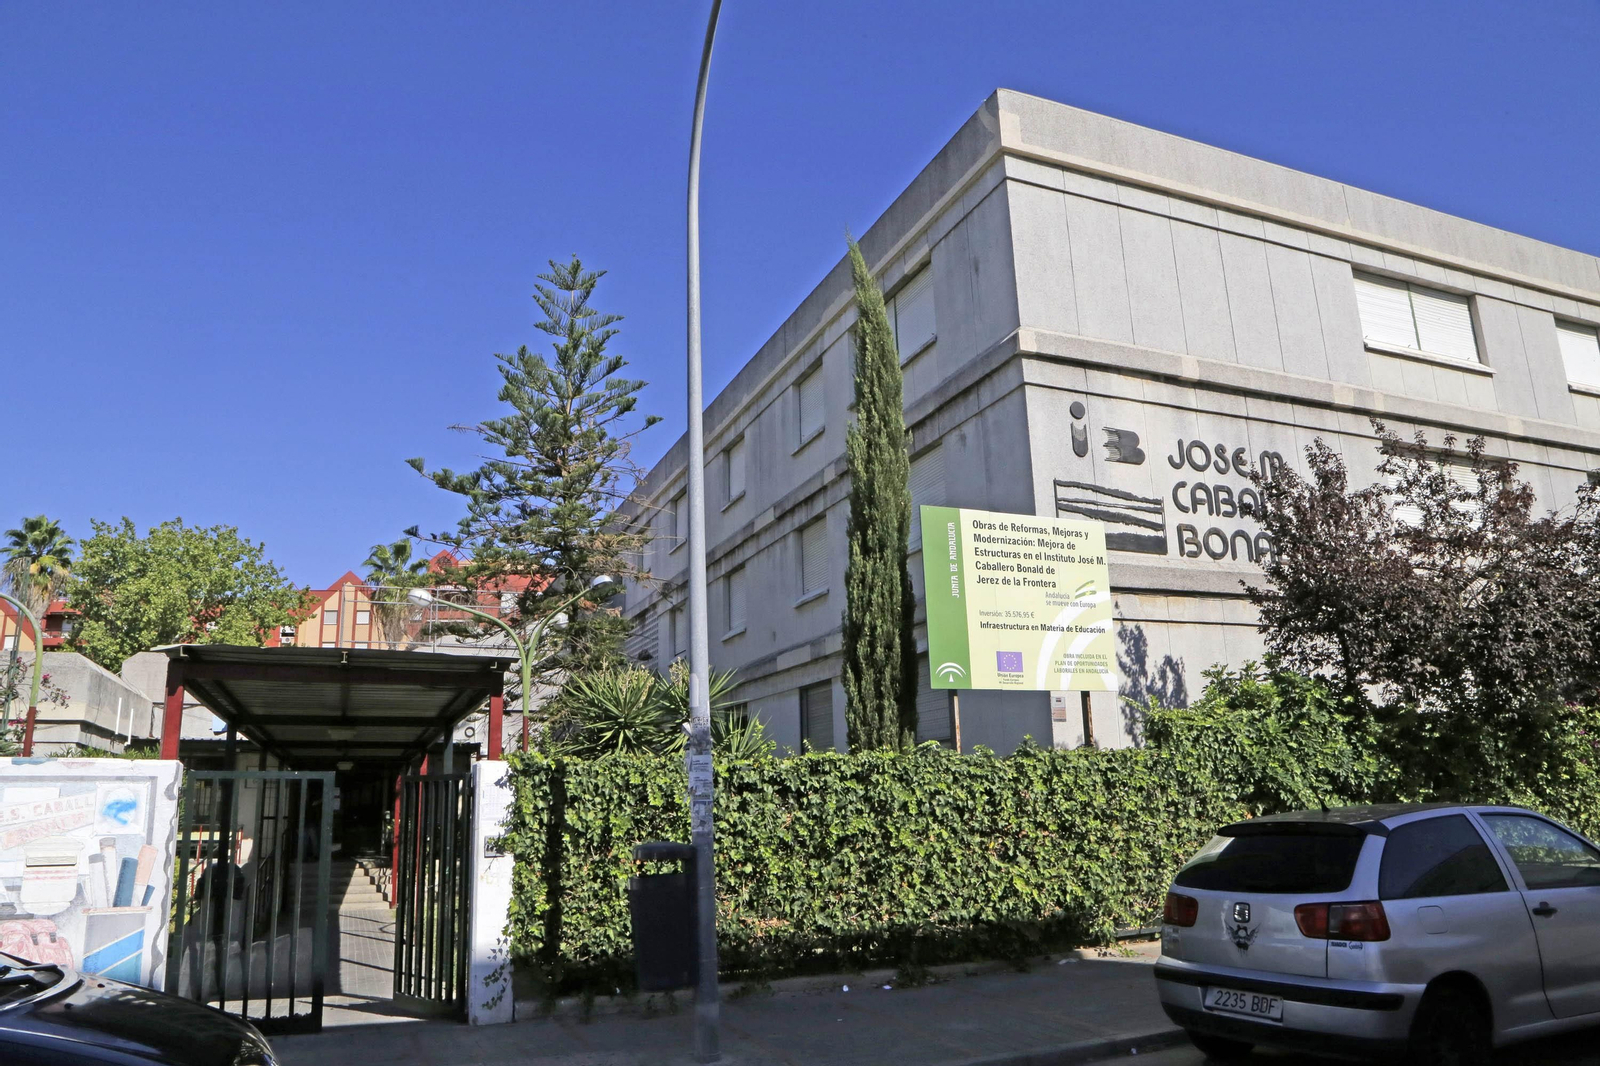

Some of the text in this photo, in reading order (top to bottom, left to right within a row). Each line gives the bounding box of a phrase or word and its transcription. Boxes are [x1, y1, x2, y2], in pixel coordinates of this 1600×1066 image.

[1168, 438, 1250, 478] JOSE
[972, 520, 1089, 540] Obras de Reformas, Mejoras y
[973, 533, 1076, 551] Modernización: Mejora de
[974, 547, 1107, 566] Estructuras en el Instituto José M.
[950, 563, 958, 572] DE
[975, 561, 1056, 575] Caballero Bonald de
[951, 575, 959, 598] JUNTA
[976, 575, 1057, 589] Jerez de la Frontera
[1080, 601, 1097, 609] Europa
[979, 609, 1003, 618] Inversión:
[980, 621, 1030, 631] Infraestructura
[1040, 624, 1065, 632] Materia
[1066, 625, 1074, 633] de
[1075, 625, 1106, 634] Educación
[1214, 990, 1278, 1014] 2235 BDF
